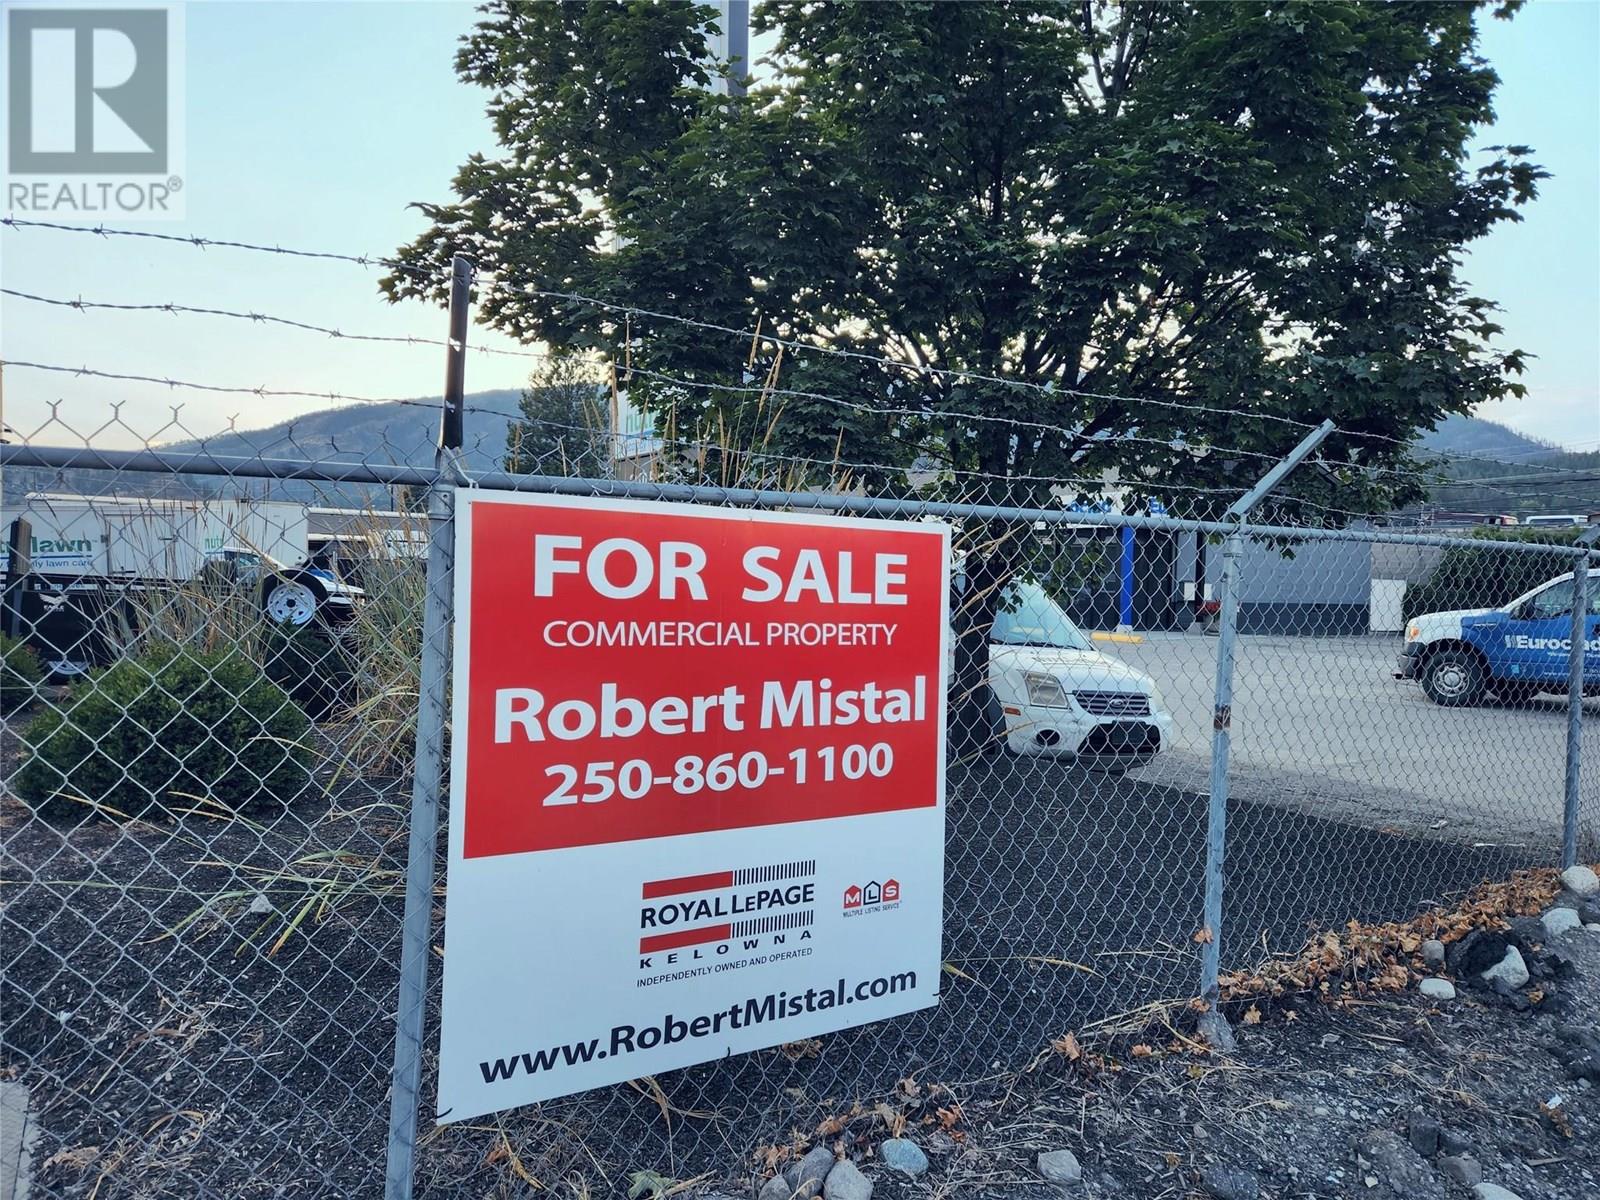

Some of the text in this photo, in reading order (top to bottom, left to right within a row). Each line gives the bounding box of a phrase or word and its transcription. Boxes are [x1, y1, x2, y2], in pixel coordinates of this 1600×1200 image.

[533, 534, 909, 605] FOR SALE
[543, 620, 898, 647] COMMERCIAL PROPERTY
[494, 675, 927, 744] Robert Mistal
[542, 742, 895, 807] 250-860-1100
[640, 896, 728, 929] ROYAL
[844, 880, 899, 908] MLS
[636, 947, 813, 988] INDEPENDENTLY OWNED AND OPERATED
[479, 970, 918, 1085] www.RobertMistal.com
